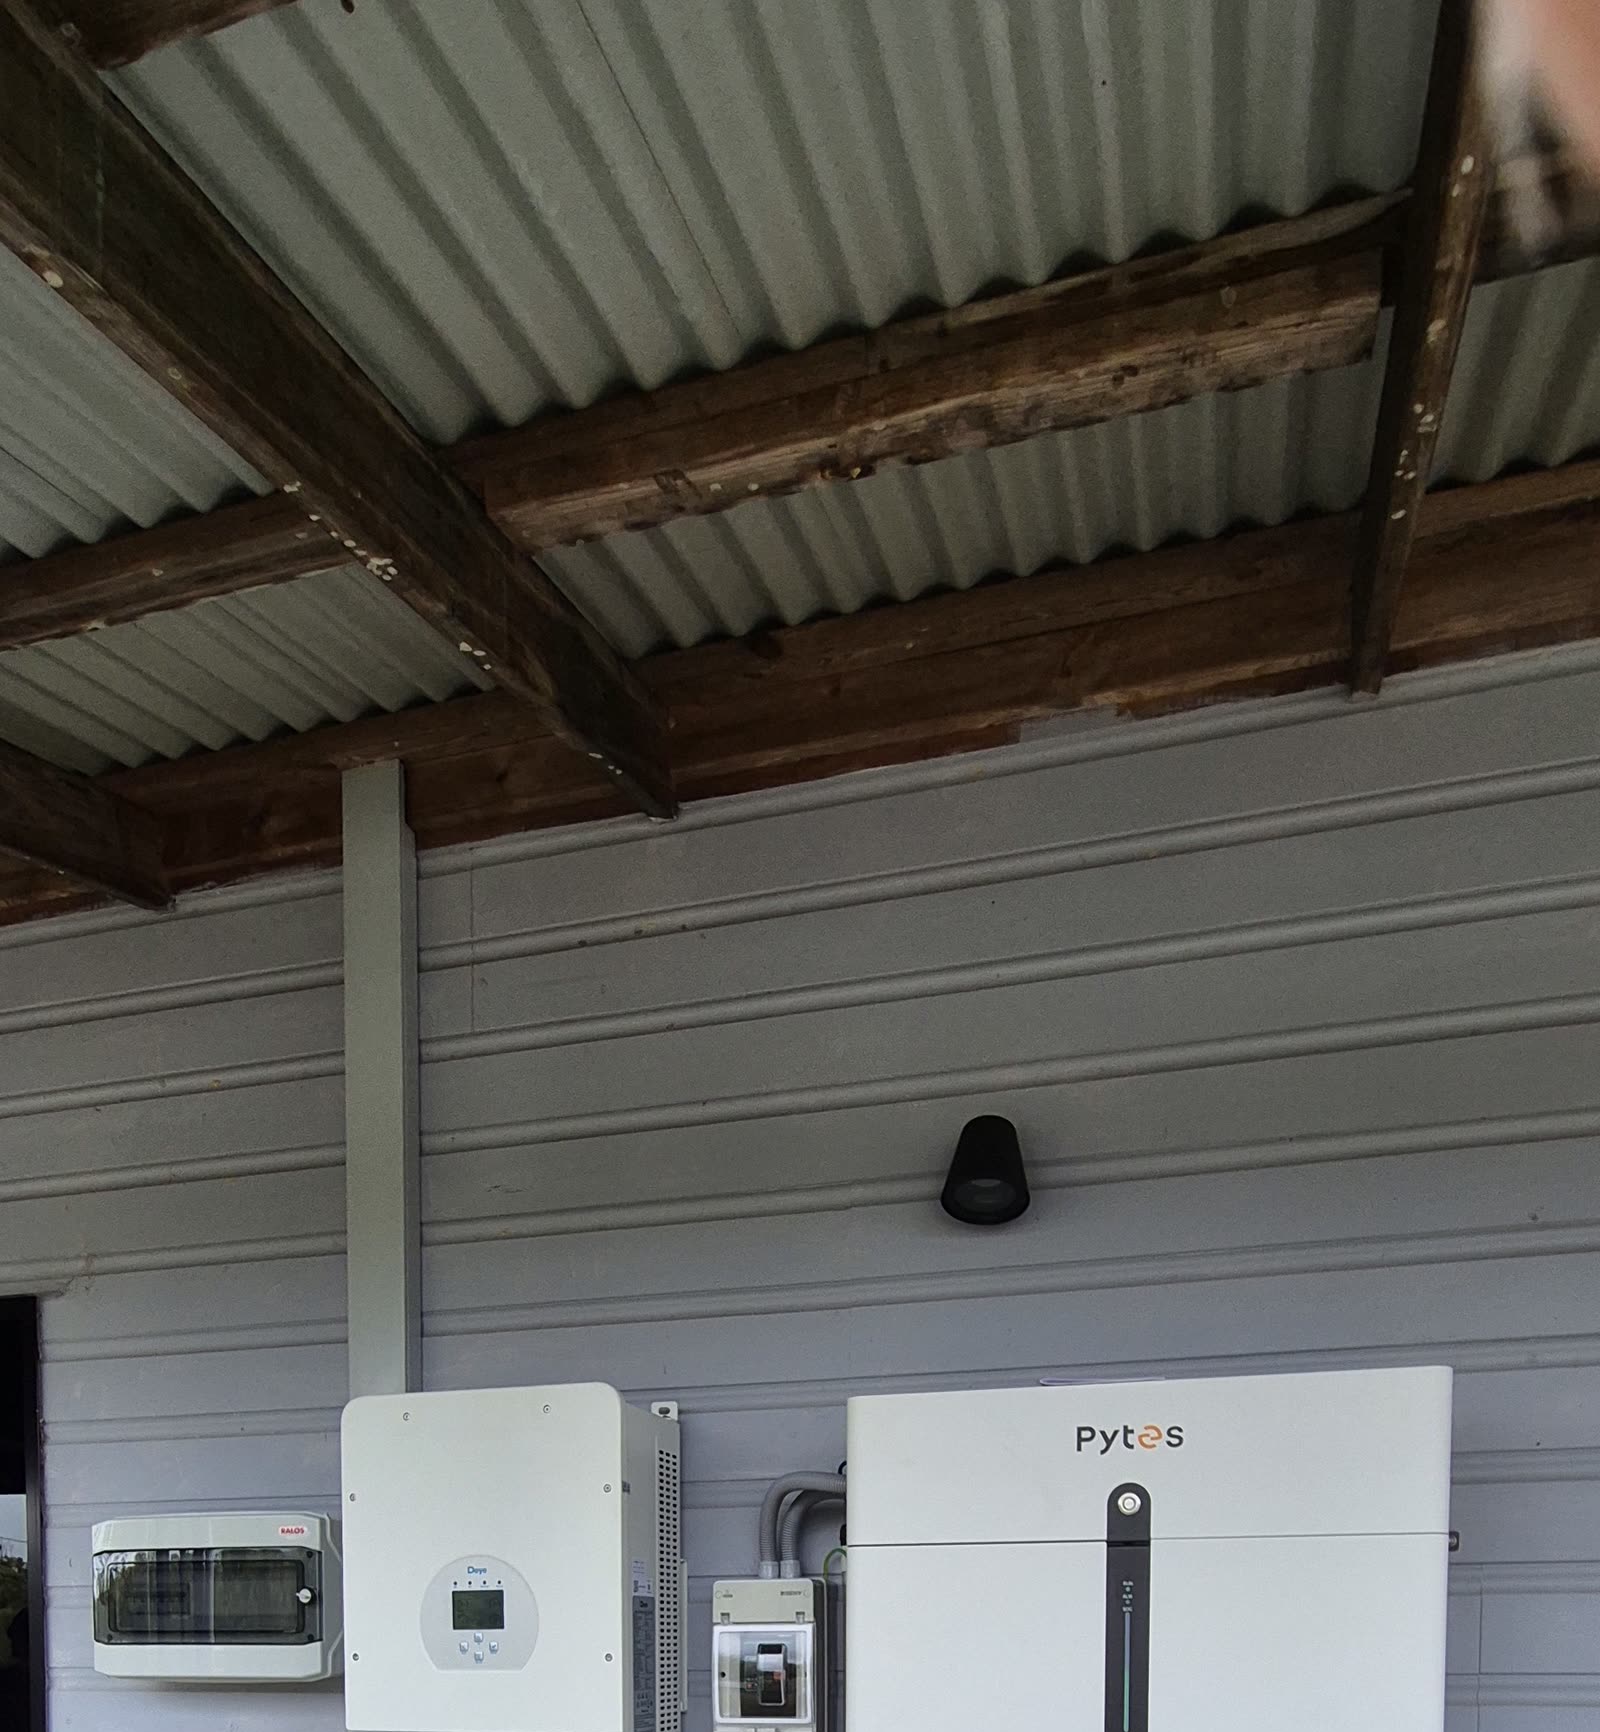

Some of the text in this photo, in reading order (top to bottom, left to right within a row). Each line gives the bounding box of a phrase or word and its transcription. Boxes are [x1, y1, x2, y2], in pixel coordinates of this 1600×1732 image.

[1076, 1424, 1184, 1456] Pytes
[281, 1527, 304, 1535] RALOS
[467, 1566, 487, 1575] Deye
